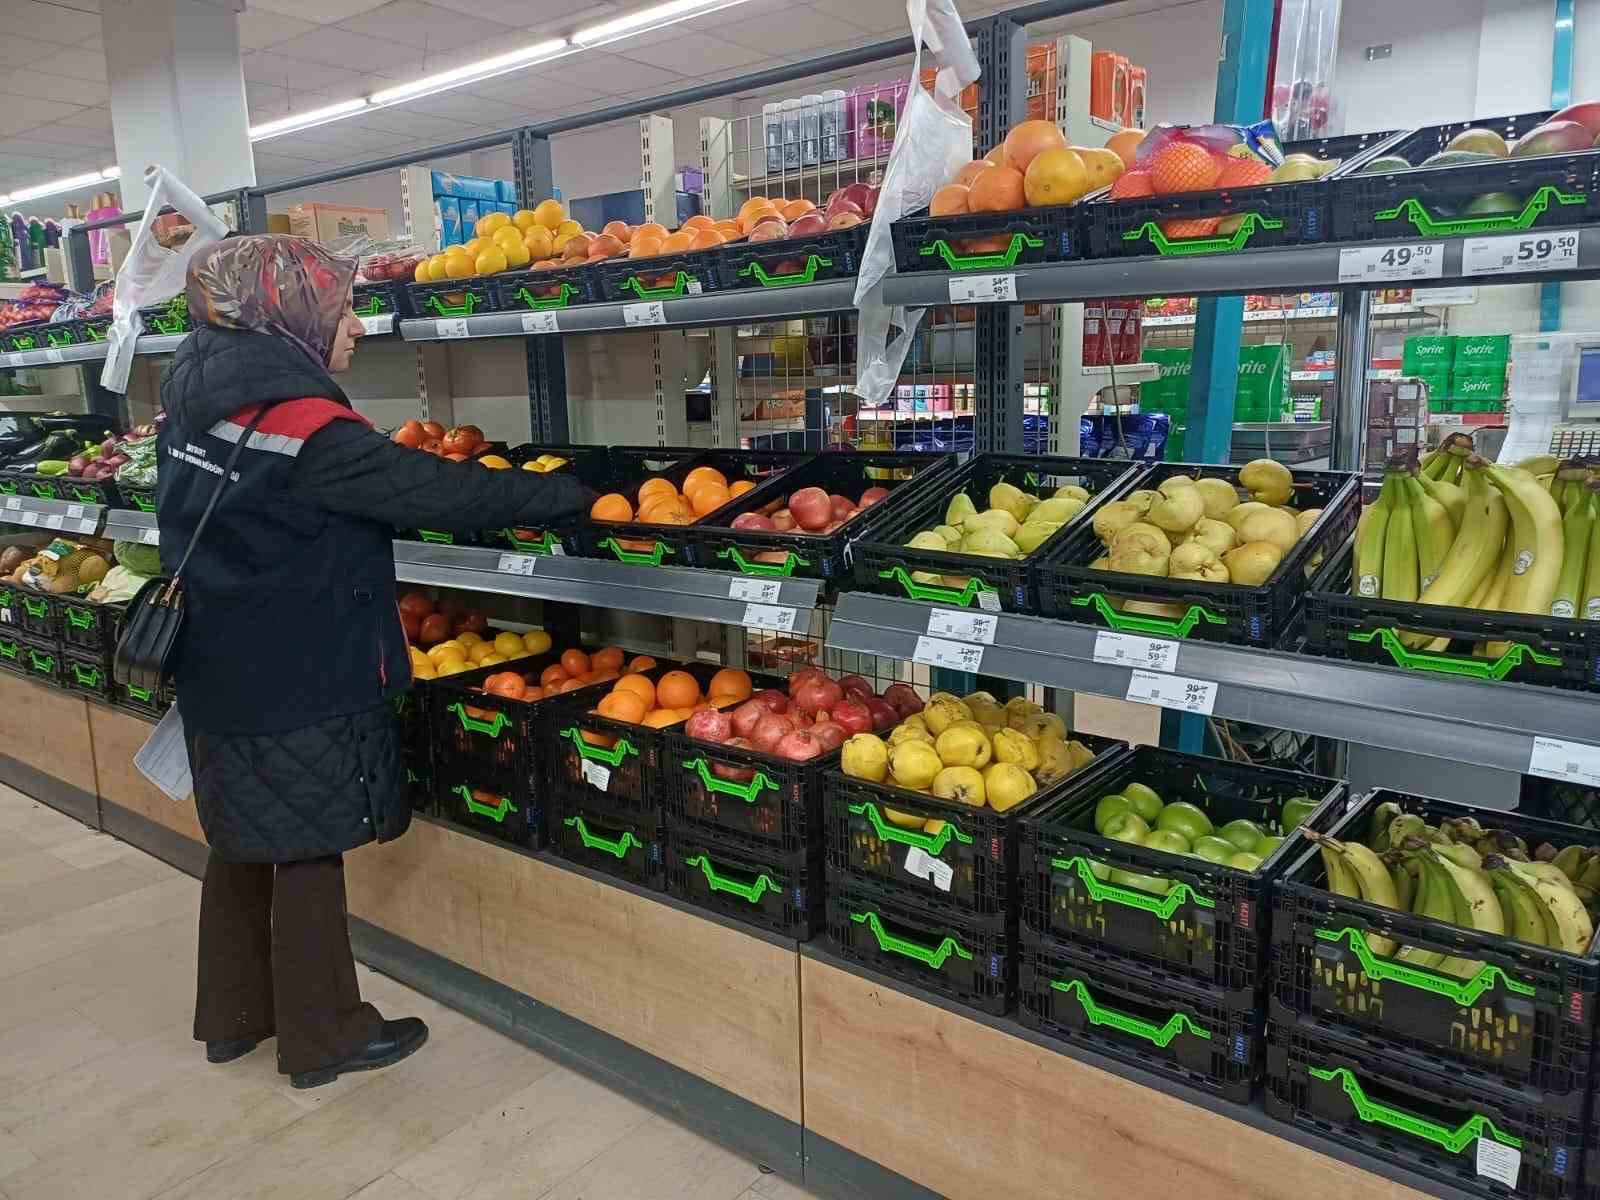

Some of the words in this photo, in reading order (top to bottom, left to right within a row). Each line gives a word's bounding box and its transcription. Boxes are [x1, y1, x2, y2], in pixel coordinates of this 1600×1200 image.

[1416, 344, 1445, 357] Sprite
[1463, 343, 1495, 357] Sprite
[1159, 361, 1192, 377] prite
[1461, 381, 1492, 393] Sprite
[1569, 992, 1584, 1021] K4317
[1553, 1145, 1568, 1175] K4312
